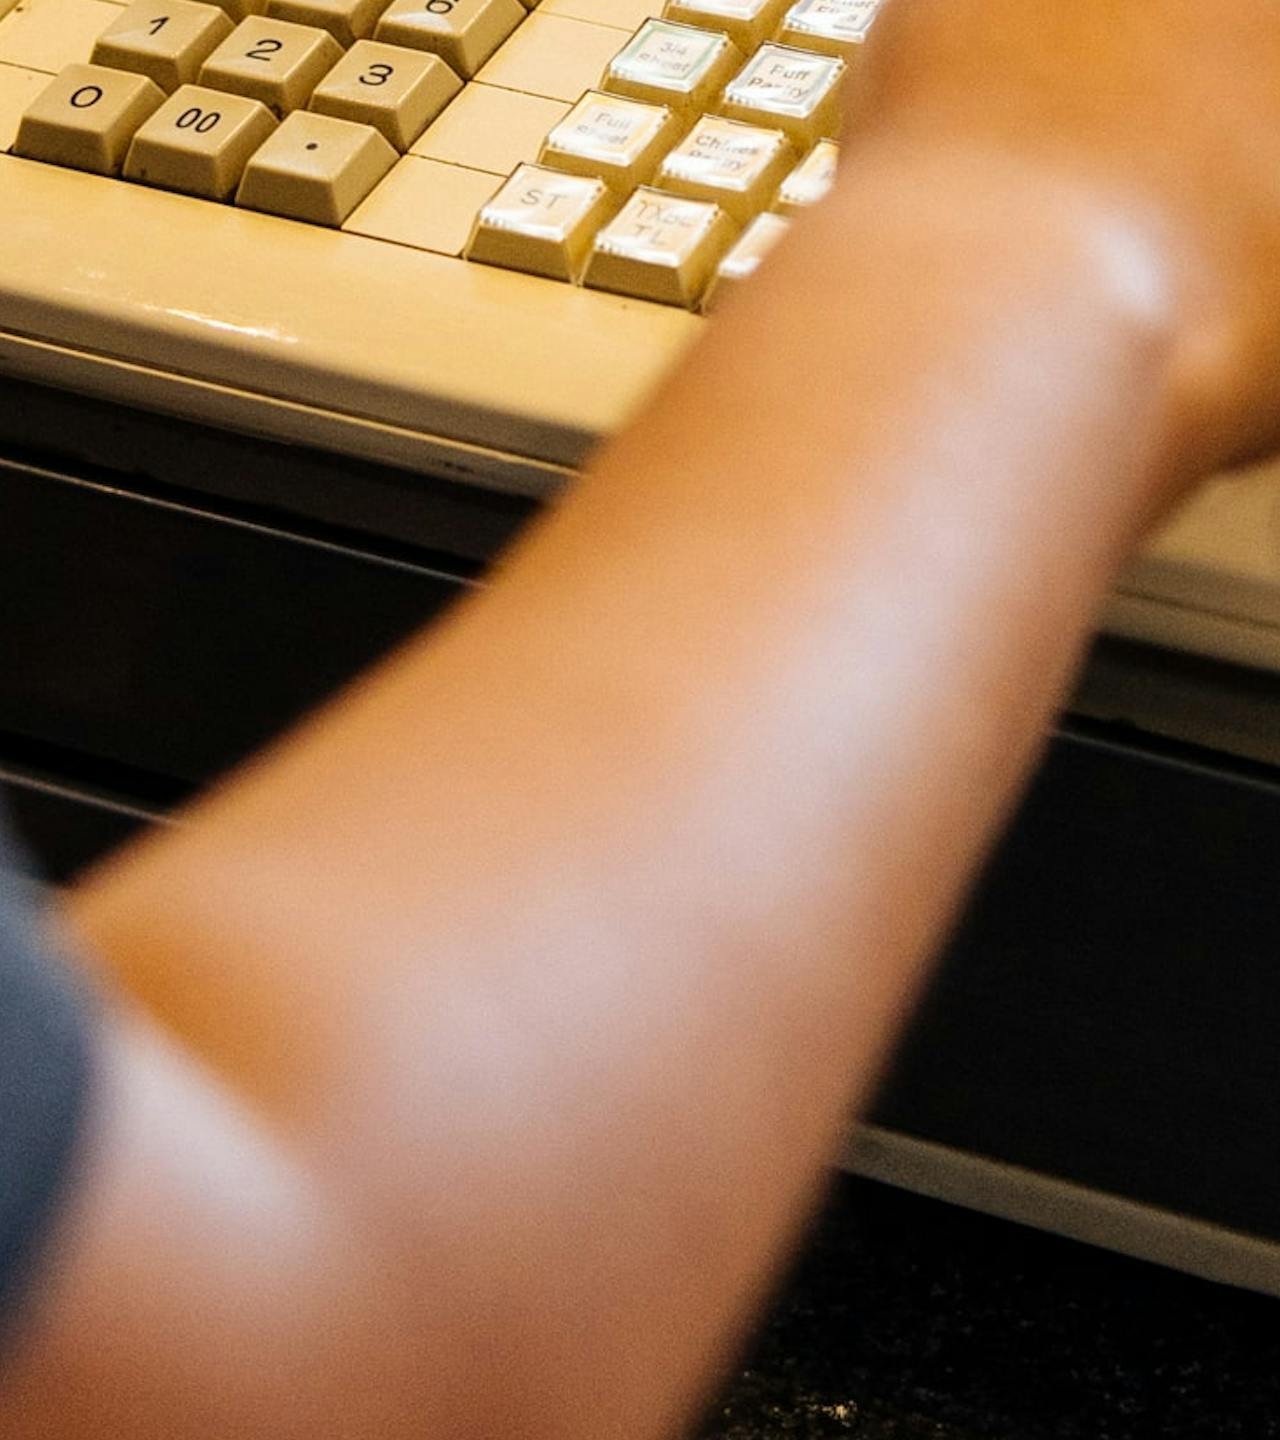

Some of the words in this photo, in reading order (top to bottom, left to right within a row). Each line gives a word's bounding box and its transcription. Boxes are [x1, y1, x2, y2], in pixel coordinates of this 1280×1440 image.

[150, 16, 169, 36] 1
[244, 39, 283, 62] 2
[358, 63, 395, 87] 3
[69, 85, 103, 109] 0
[175, 107, 221, 133] 00
[520, 189, 567, 210] ST
